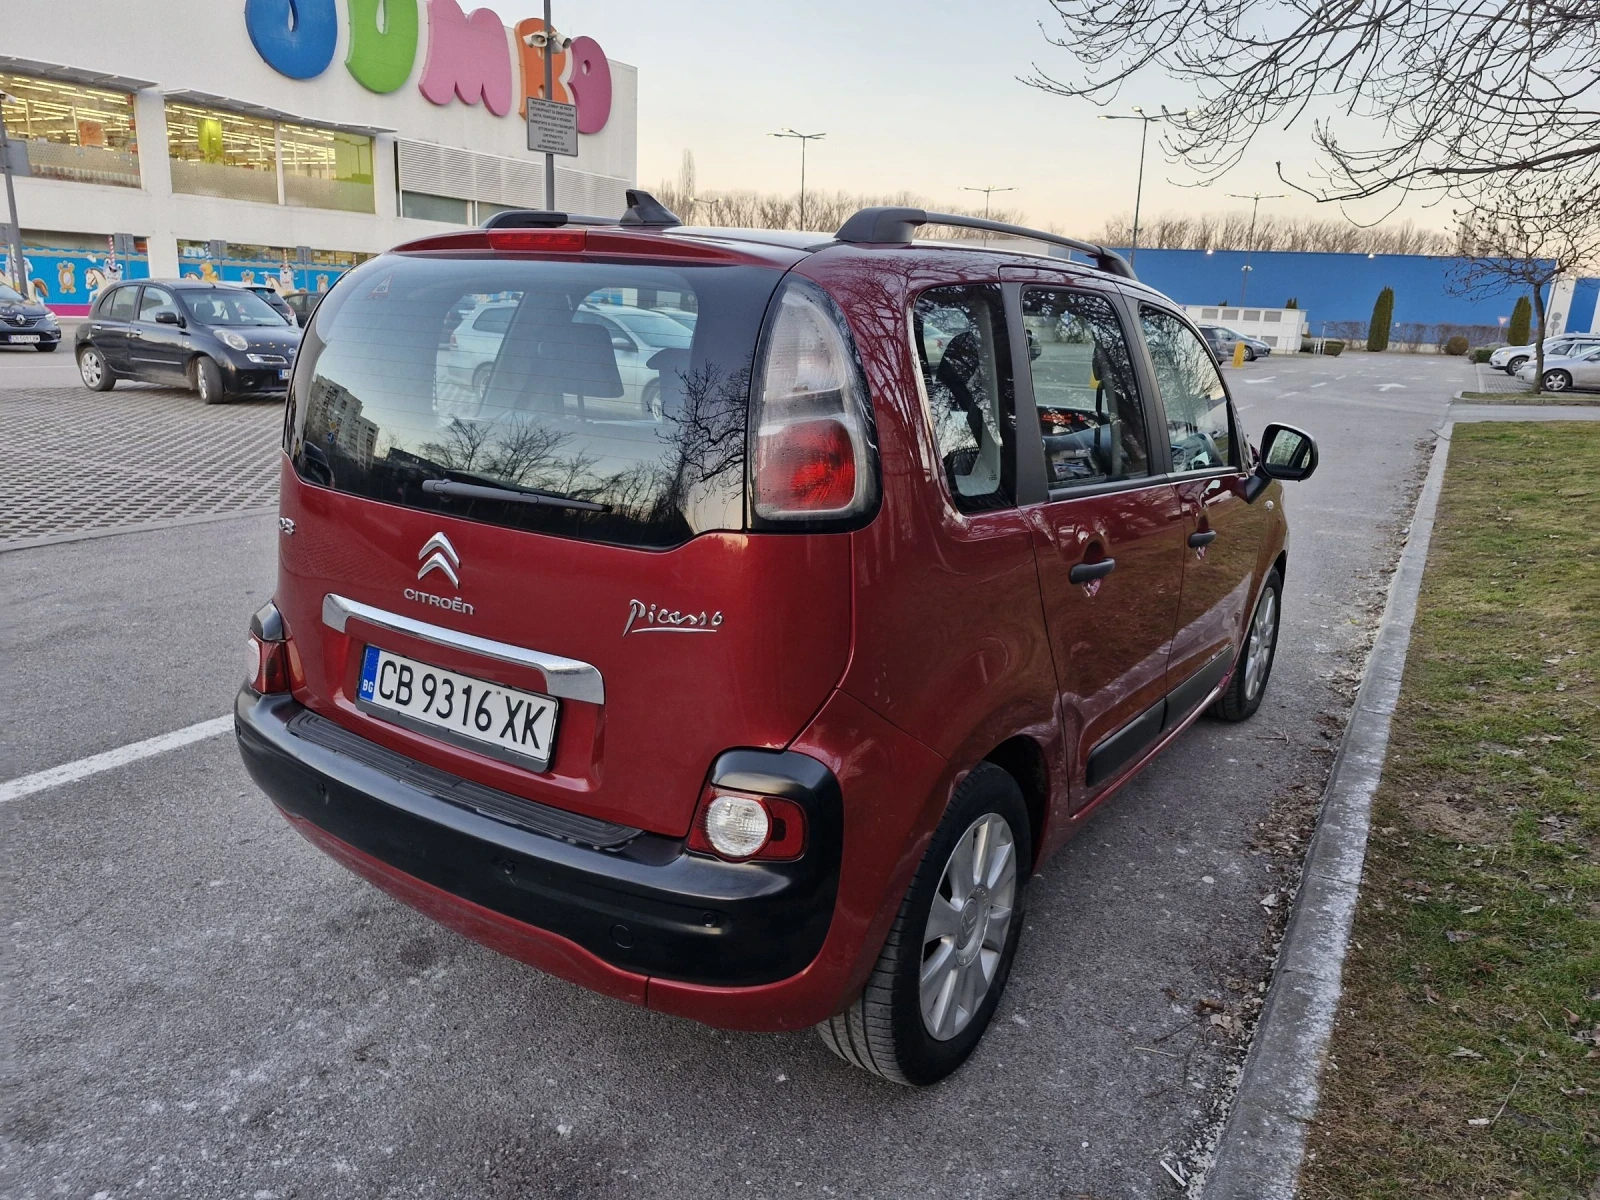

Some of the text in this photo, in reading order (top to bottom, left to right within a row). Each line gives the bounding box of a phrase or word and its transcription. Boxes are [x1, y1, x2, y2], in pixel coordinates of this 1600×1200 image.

[404, 588, 475, 616] CITROËN
[622, 598, 724, 637] Picasso
[362, 679, 374, 694] BG
[379, 660, 547, 750] CB 9316 XK
